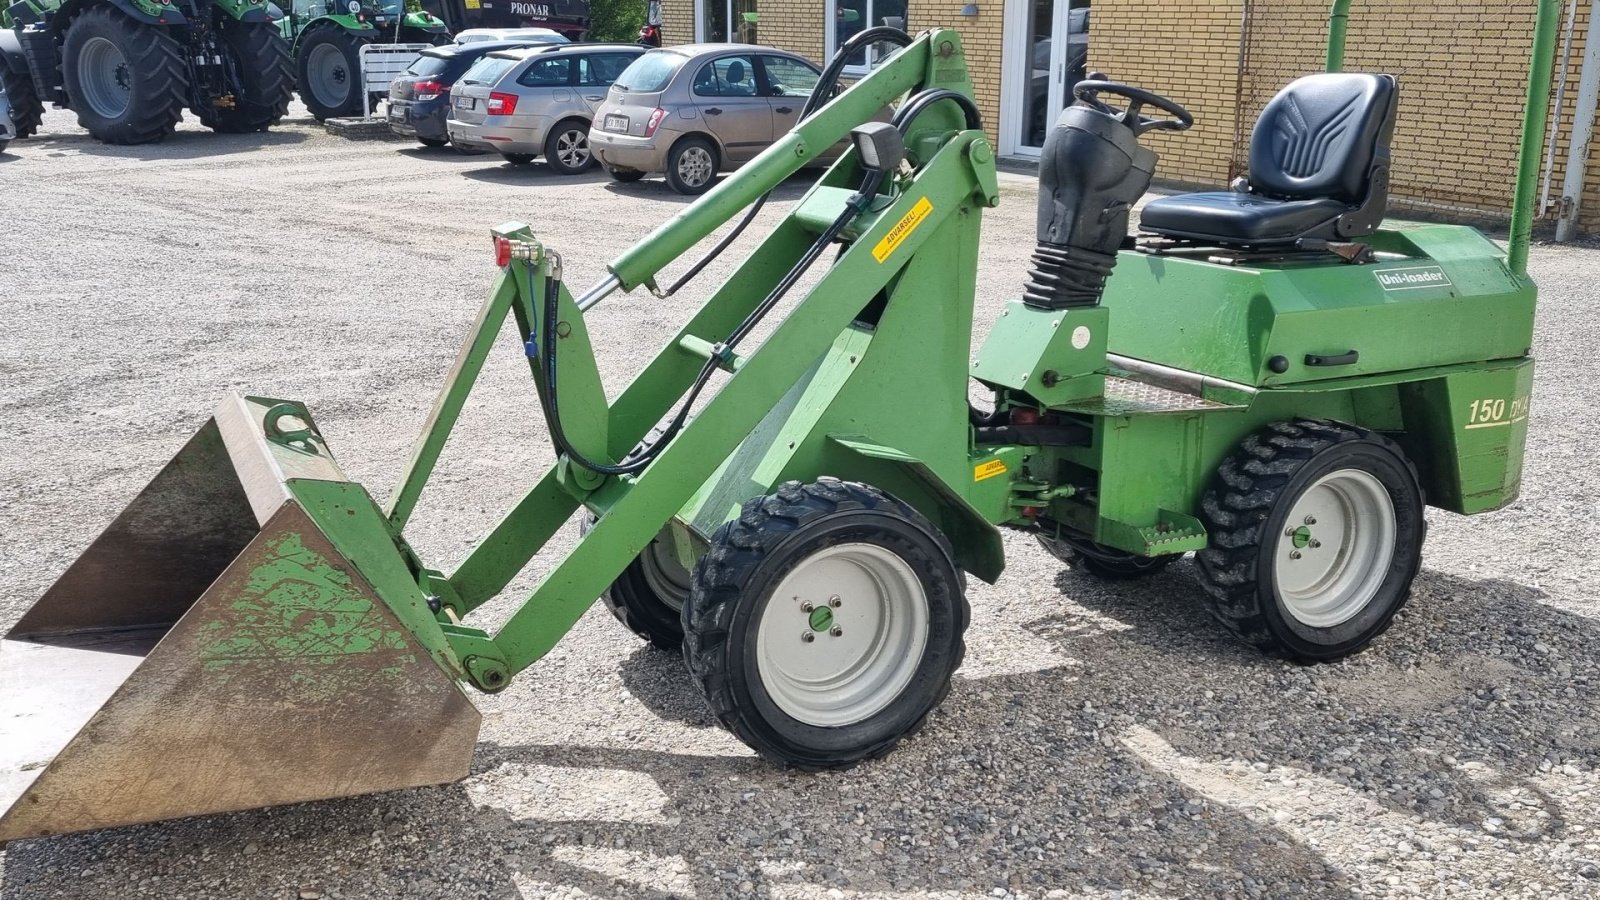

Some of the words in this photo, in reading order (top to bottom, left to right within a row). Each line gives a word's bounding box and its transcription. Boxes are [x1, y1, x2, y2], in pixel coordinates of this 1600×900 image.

[511, 2, 549, 16] PRONAR
[886, 210, 917, 245] ADVARSEL!
[1379, 270, 1443, 285] Uni-loader
[1469, 398, 1505, 423] 150
